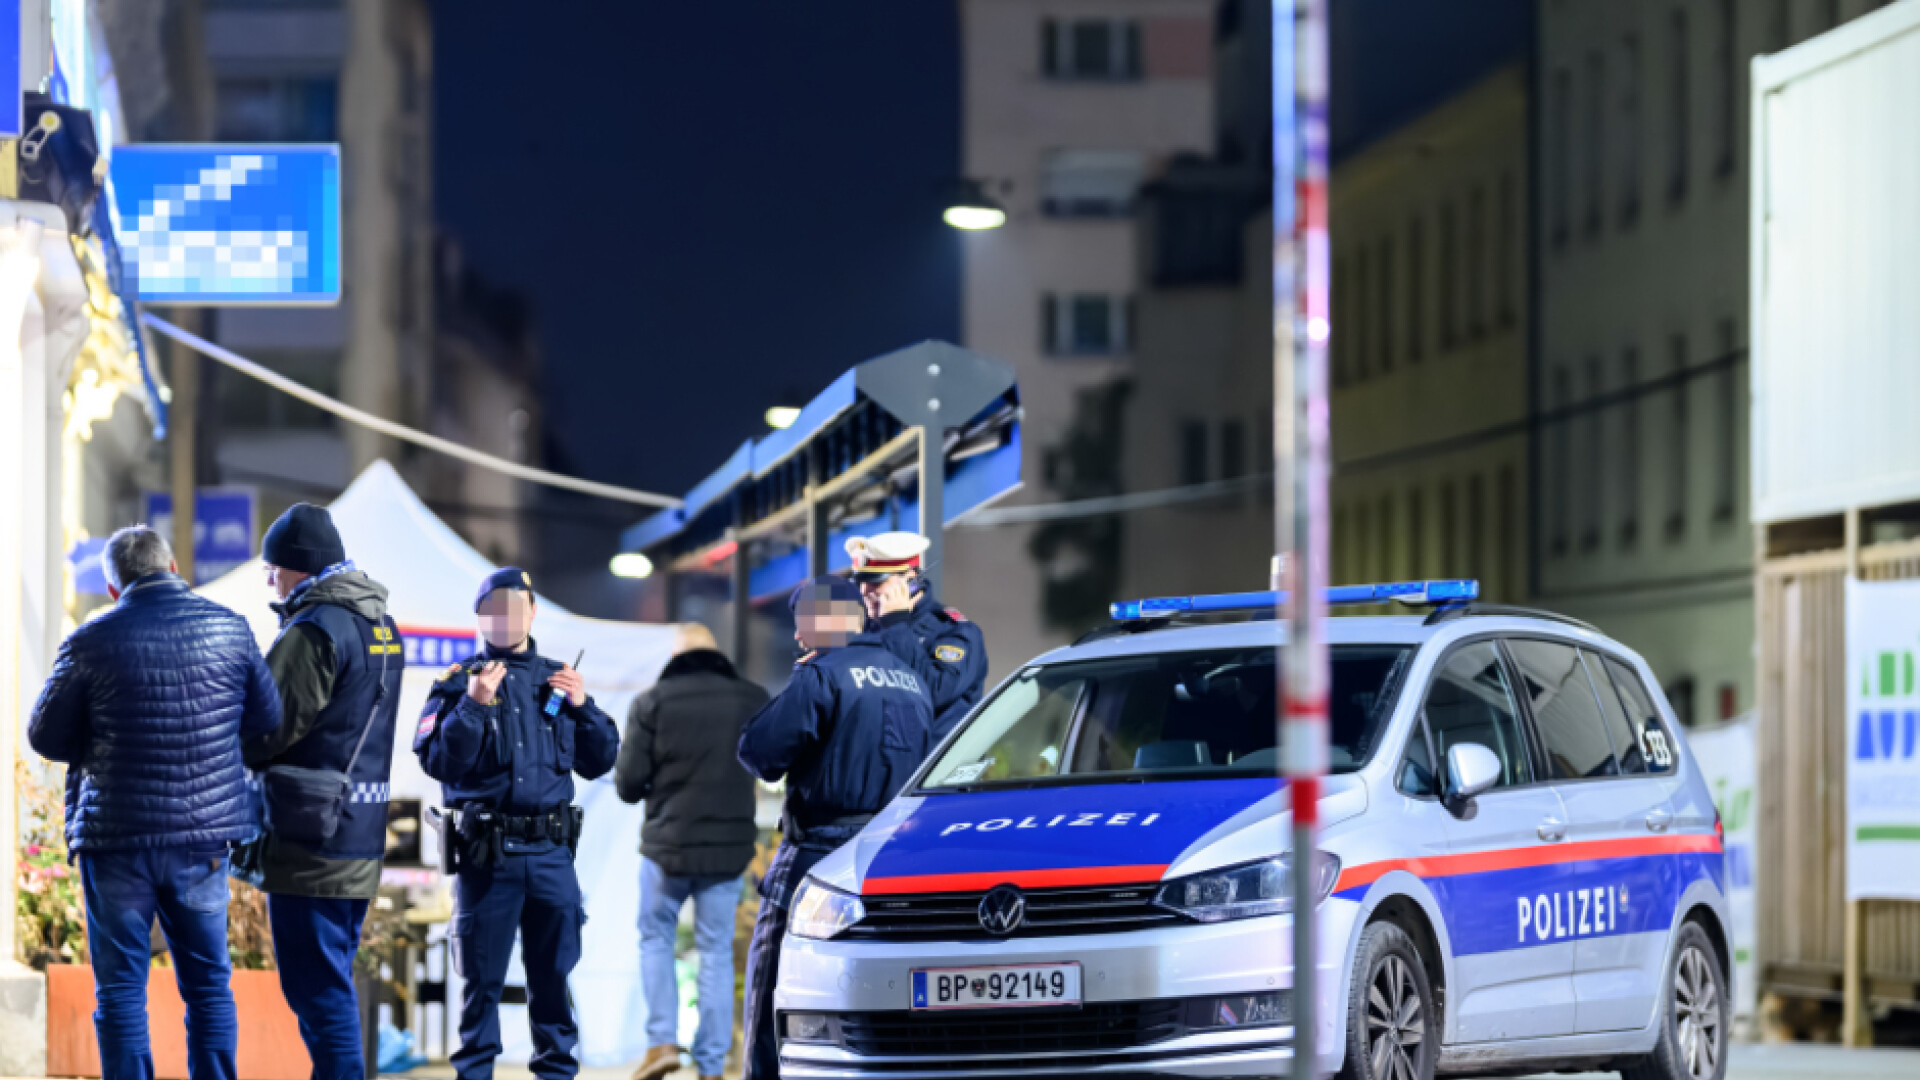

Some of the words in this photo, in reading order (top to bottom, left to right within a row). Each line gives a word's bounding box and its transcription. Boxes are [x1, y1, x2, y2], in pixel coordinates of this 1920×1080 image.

[940, 812, 1161, 837] POLIZEI
[1517, 885, 1615, 942] POLIZEI
[938, 974, 968, 1001] BP
[988, 970, 1065, 1000] 92149
